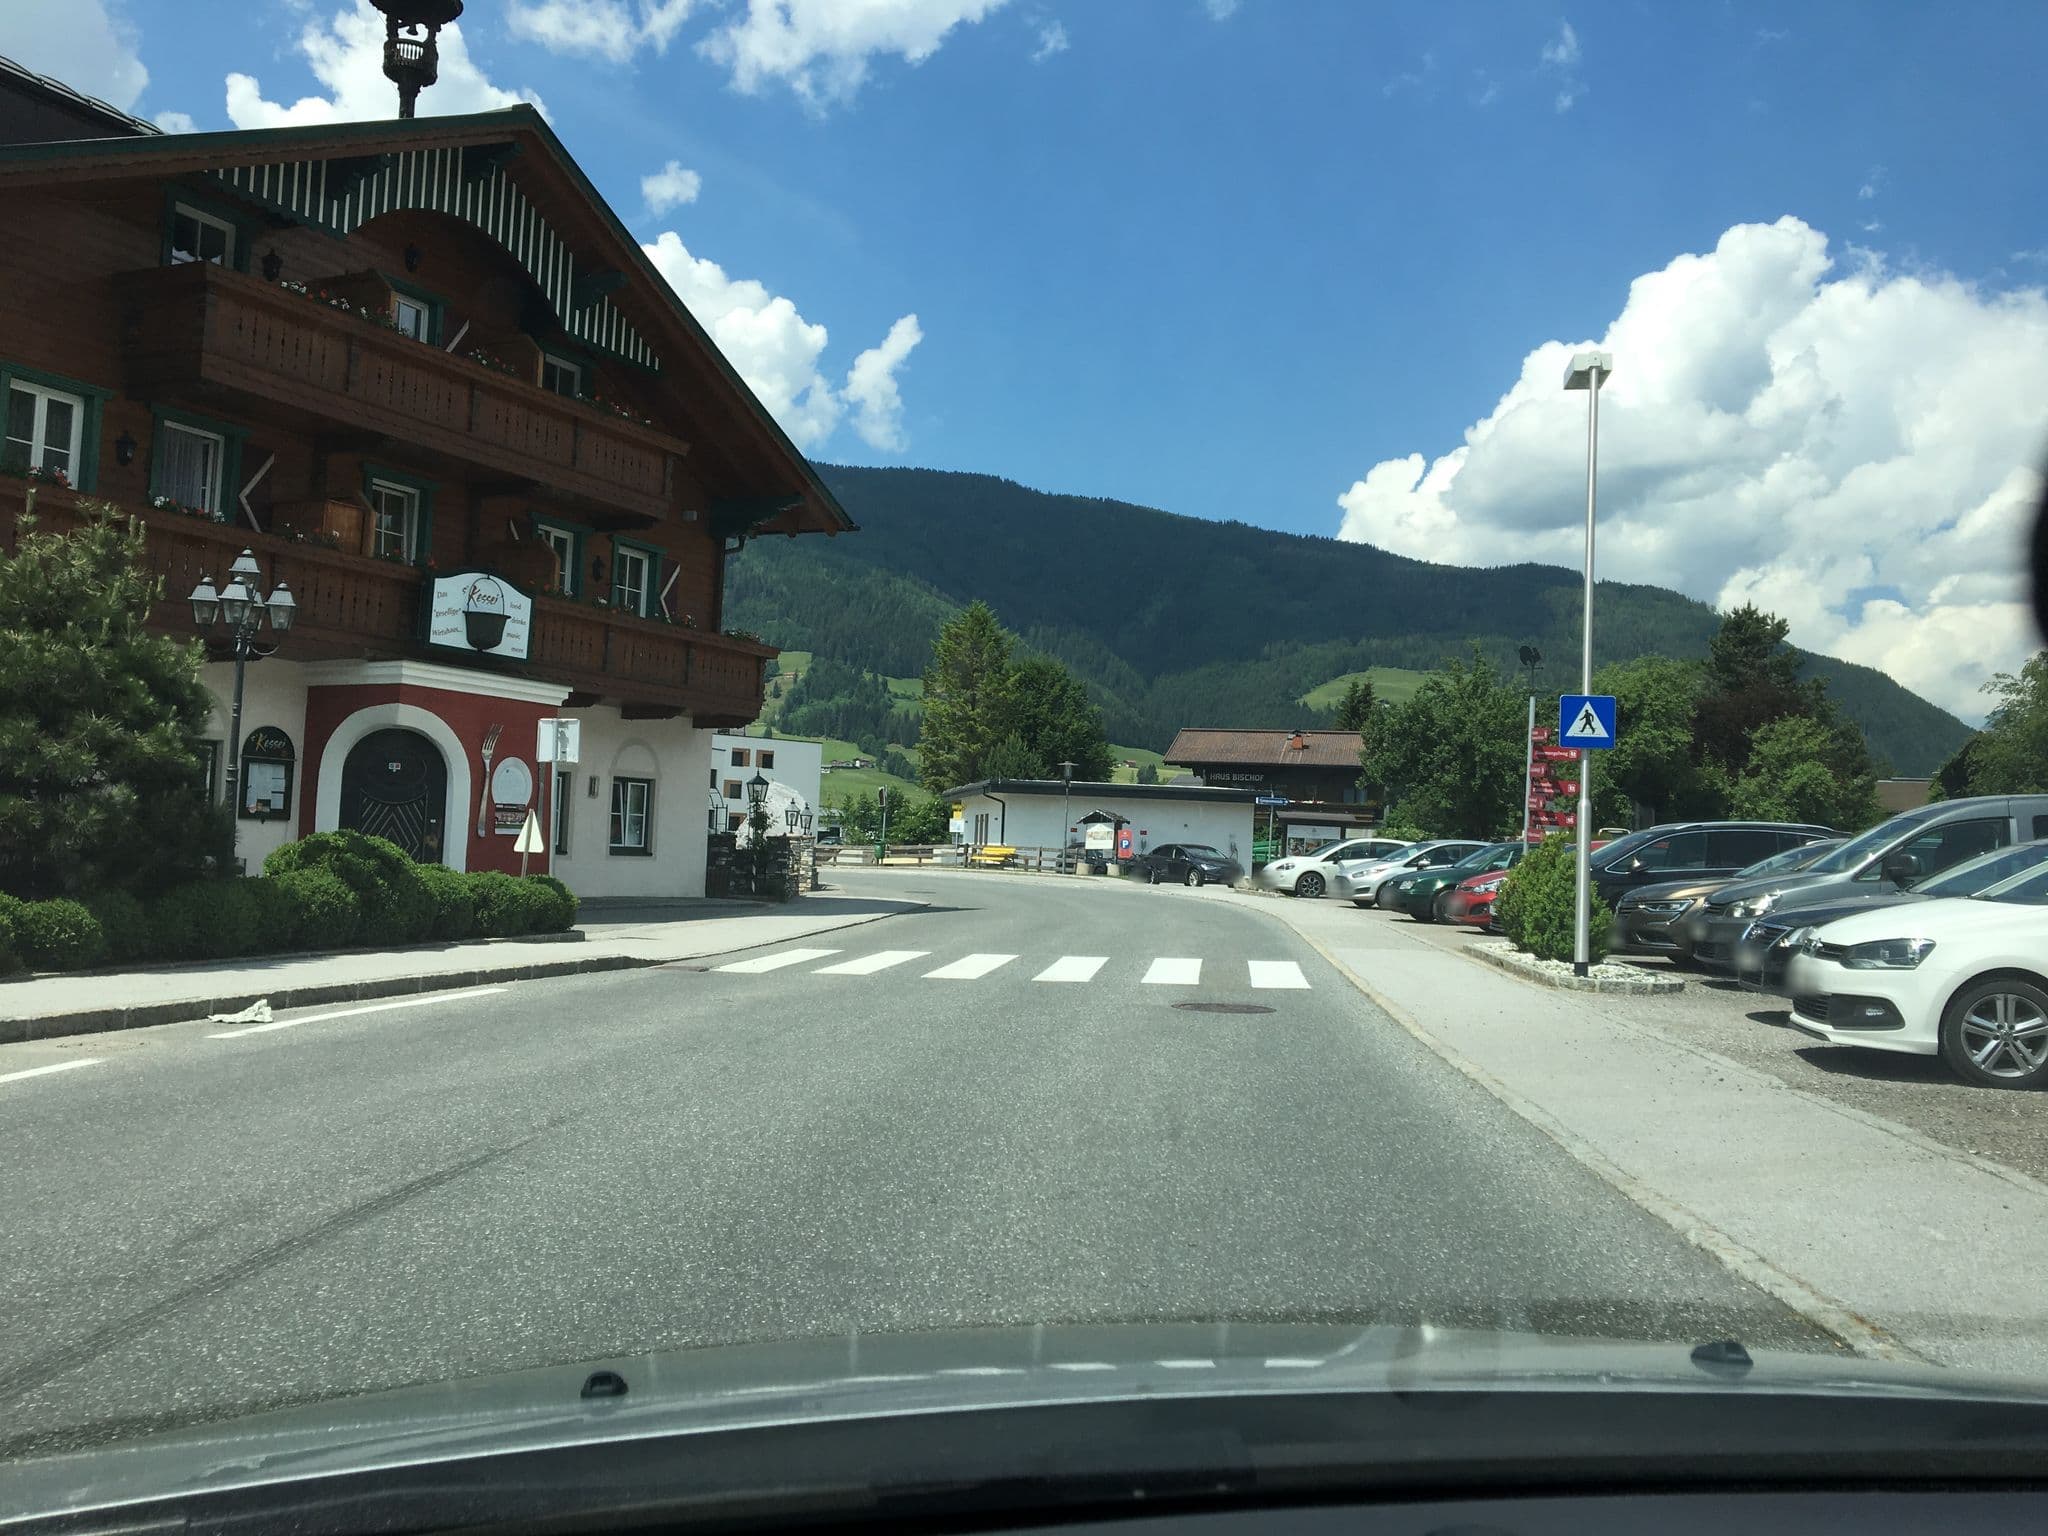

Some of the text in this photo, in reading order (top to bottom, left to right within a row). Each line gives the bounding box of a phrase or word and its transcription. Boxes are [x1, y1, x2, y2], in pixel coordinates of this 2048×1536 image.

[1210, 773, 1265, 782] HAUS BISCHOF
[1122, 840, 1130, 849] P
